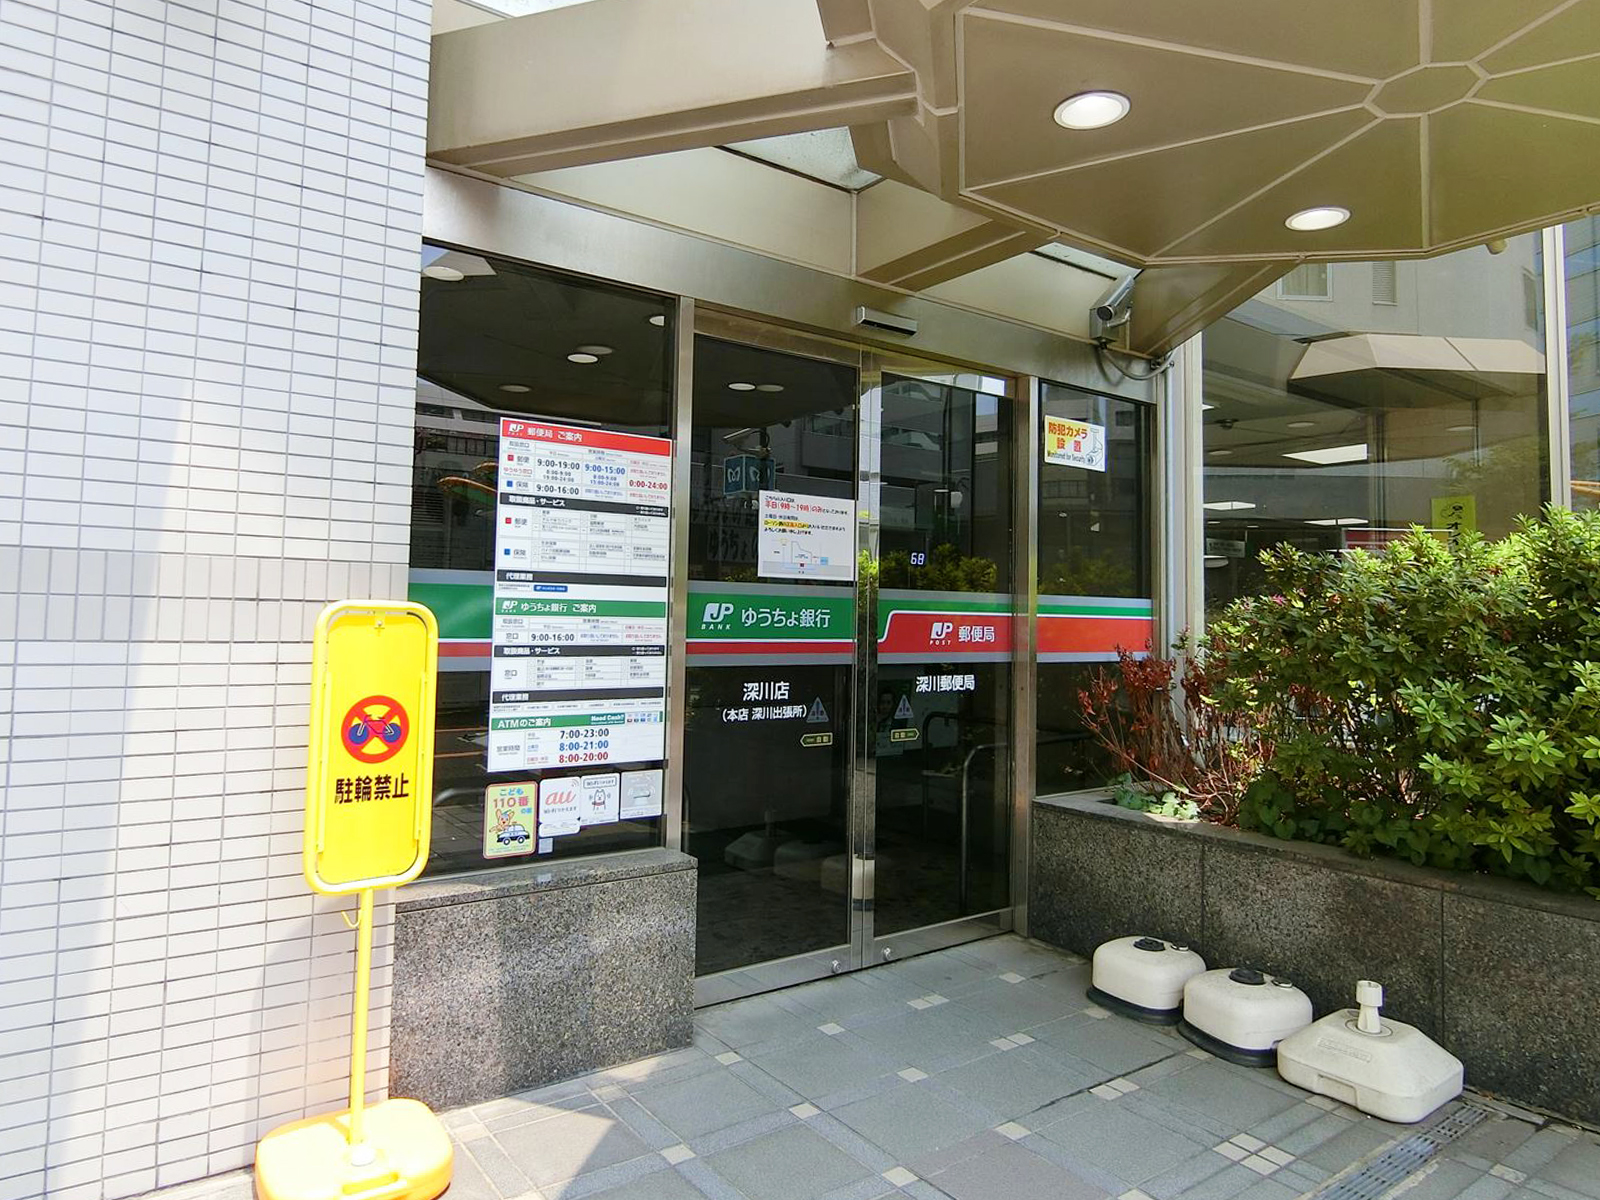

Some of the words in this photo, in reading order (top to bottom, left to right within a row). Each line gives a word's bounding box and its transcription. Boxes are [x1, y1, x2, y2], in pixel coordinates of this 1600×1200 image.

[509, 423, 525, 433] JP
[527, 427, 553, 438] 郵便局
[557, 431, 583, 442] ご案内
[1048, 421, 1088, 439] 防犯カメラ
[1056, 437, 1082, 452] 設置
[537, 458, 581, 470] 9:00-19:00
[584, 463, 626, 475] 9:00-15:00
[536, 484, 580, 495] 9:00-16:00
[629, 479, 668, 491] 0:00-24:00
[911, 552, 925, 565] 68
[502, 600, 518, 610] JP
[521, 602, 568, 613] ゆうちょ銀行
[572, 603, 597, 613] ご案内
[703, 603, 734, 623] JP
[741, 608, 831, 628] ゆうちょ銀行
[531, 633, 575, 642] 9:00-16:00
[930, 622, 953, 640] JP
[958, 625, 995, 643] 郵便局
[916, 675, 976, 693] 深川郵便局
[743, 681, 790, 701] 深川店
[497, 717, 552, 728] ATMのご案内
[560, 728, 609, 739] 7:00-23:00
[559, 740, 609, 752] 8:00-21:00
[559, 752, 609, 763] 8:00-20:00
[334, 773, 409, 804] 駐輪禁止
[499, 788, 524, 796] こども
[493, 796, 529, 809] 110番
[545, 789, 576, 806] au
